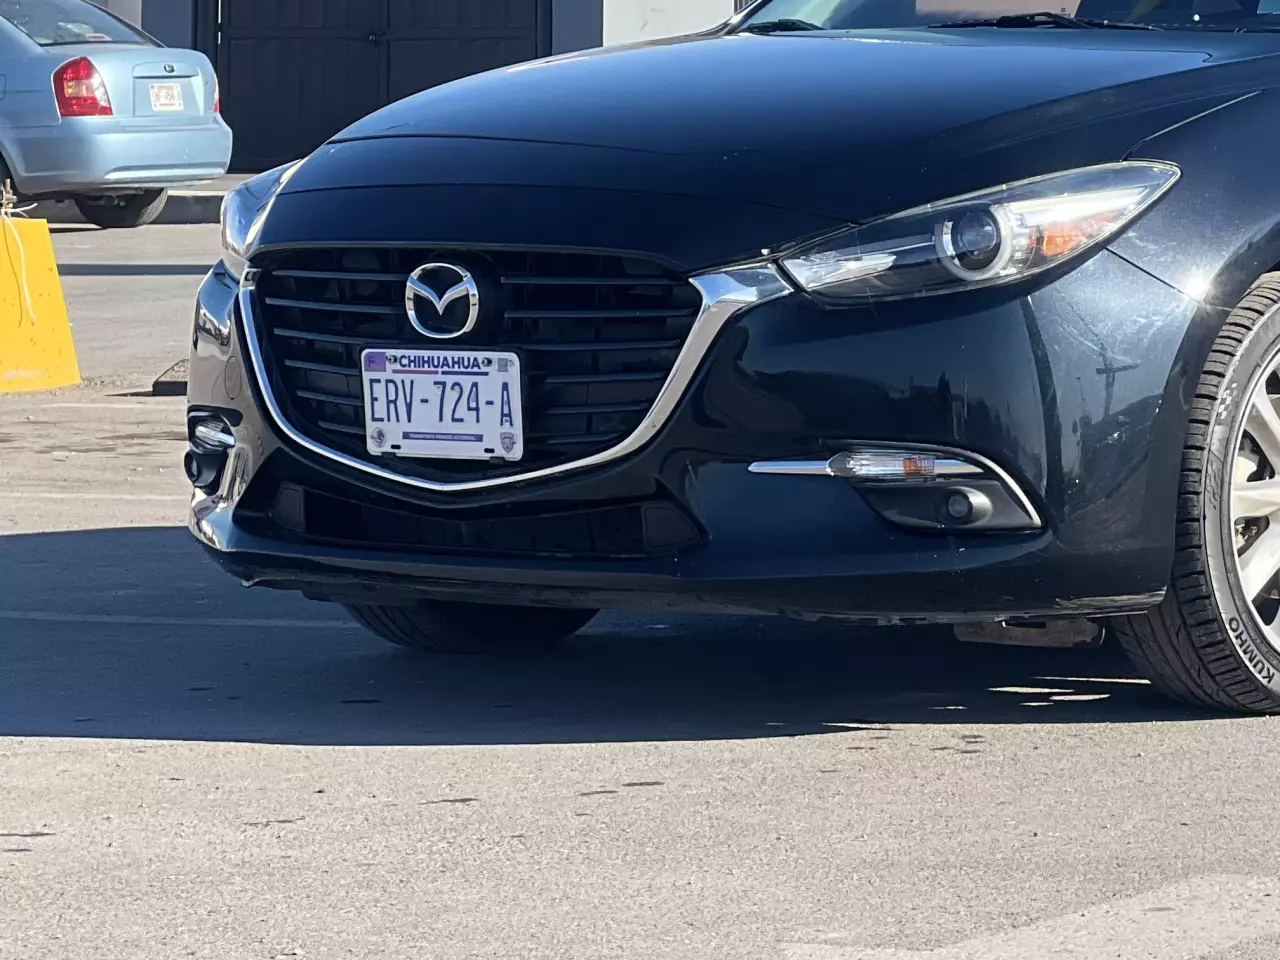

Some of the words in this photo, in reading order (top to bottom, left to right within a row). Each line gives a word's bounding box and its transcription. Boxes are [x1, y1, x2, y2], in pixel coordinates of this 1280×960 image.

[398, 354, 482, 370] CHIHUAHUA
[368, 378, 514, 427] ERV-724-A
[1228, 616, 1276, 685] KUMHO
